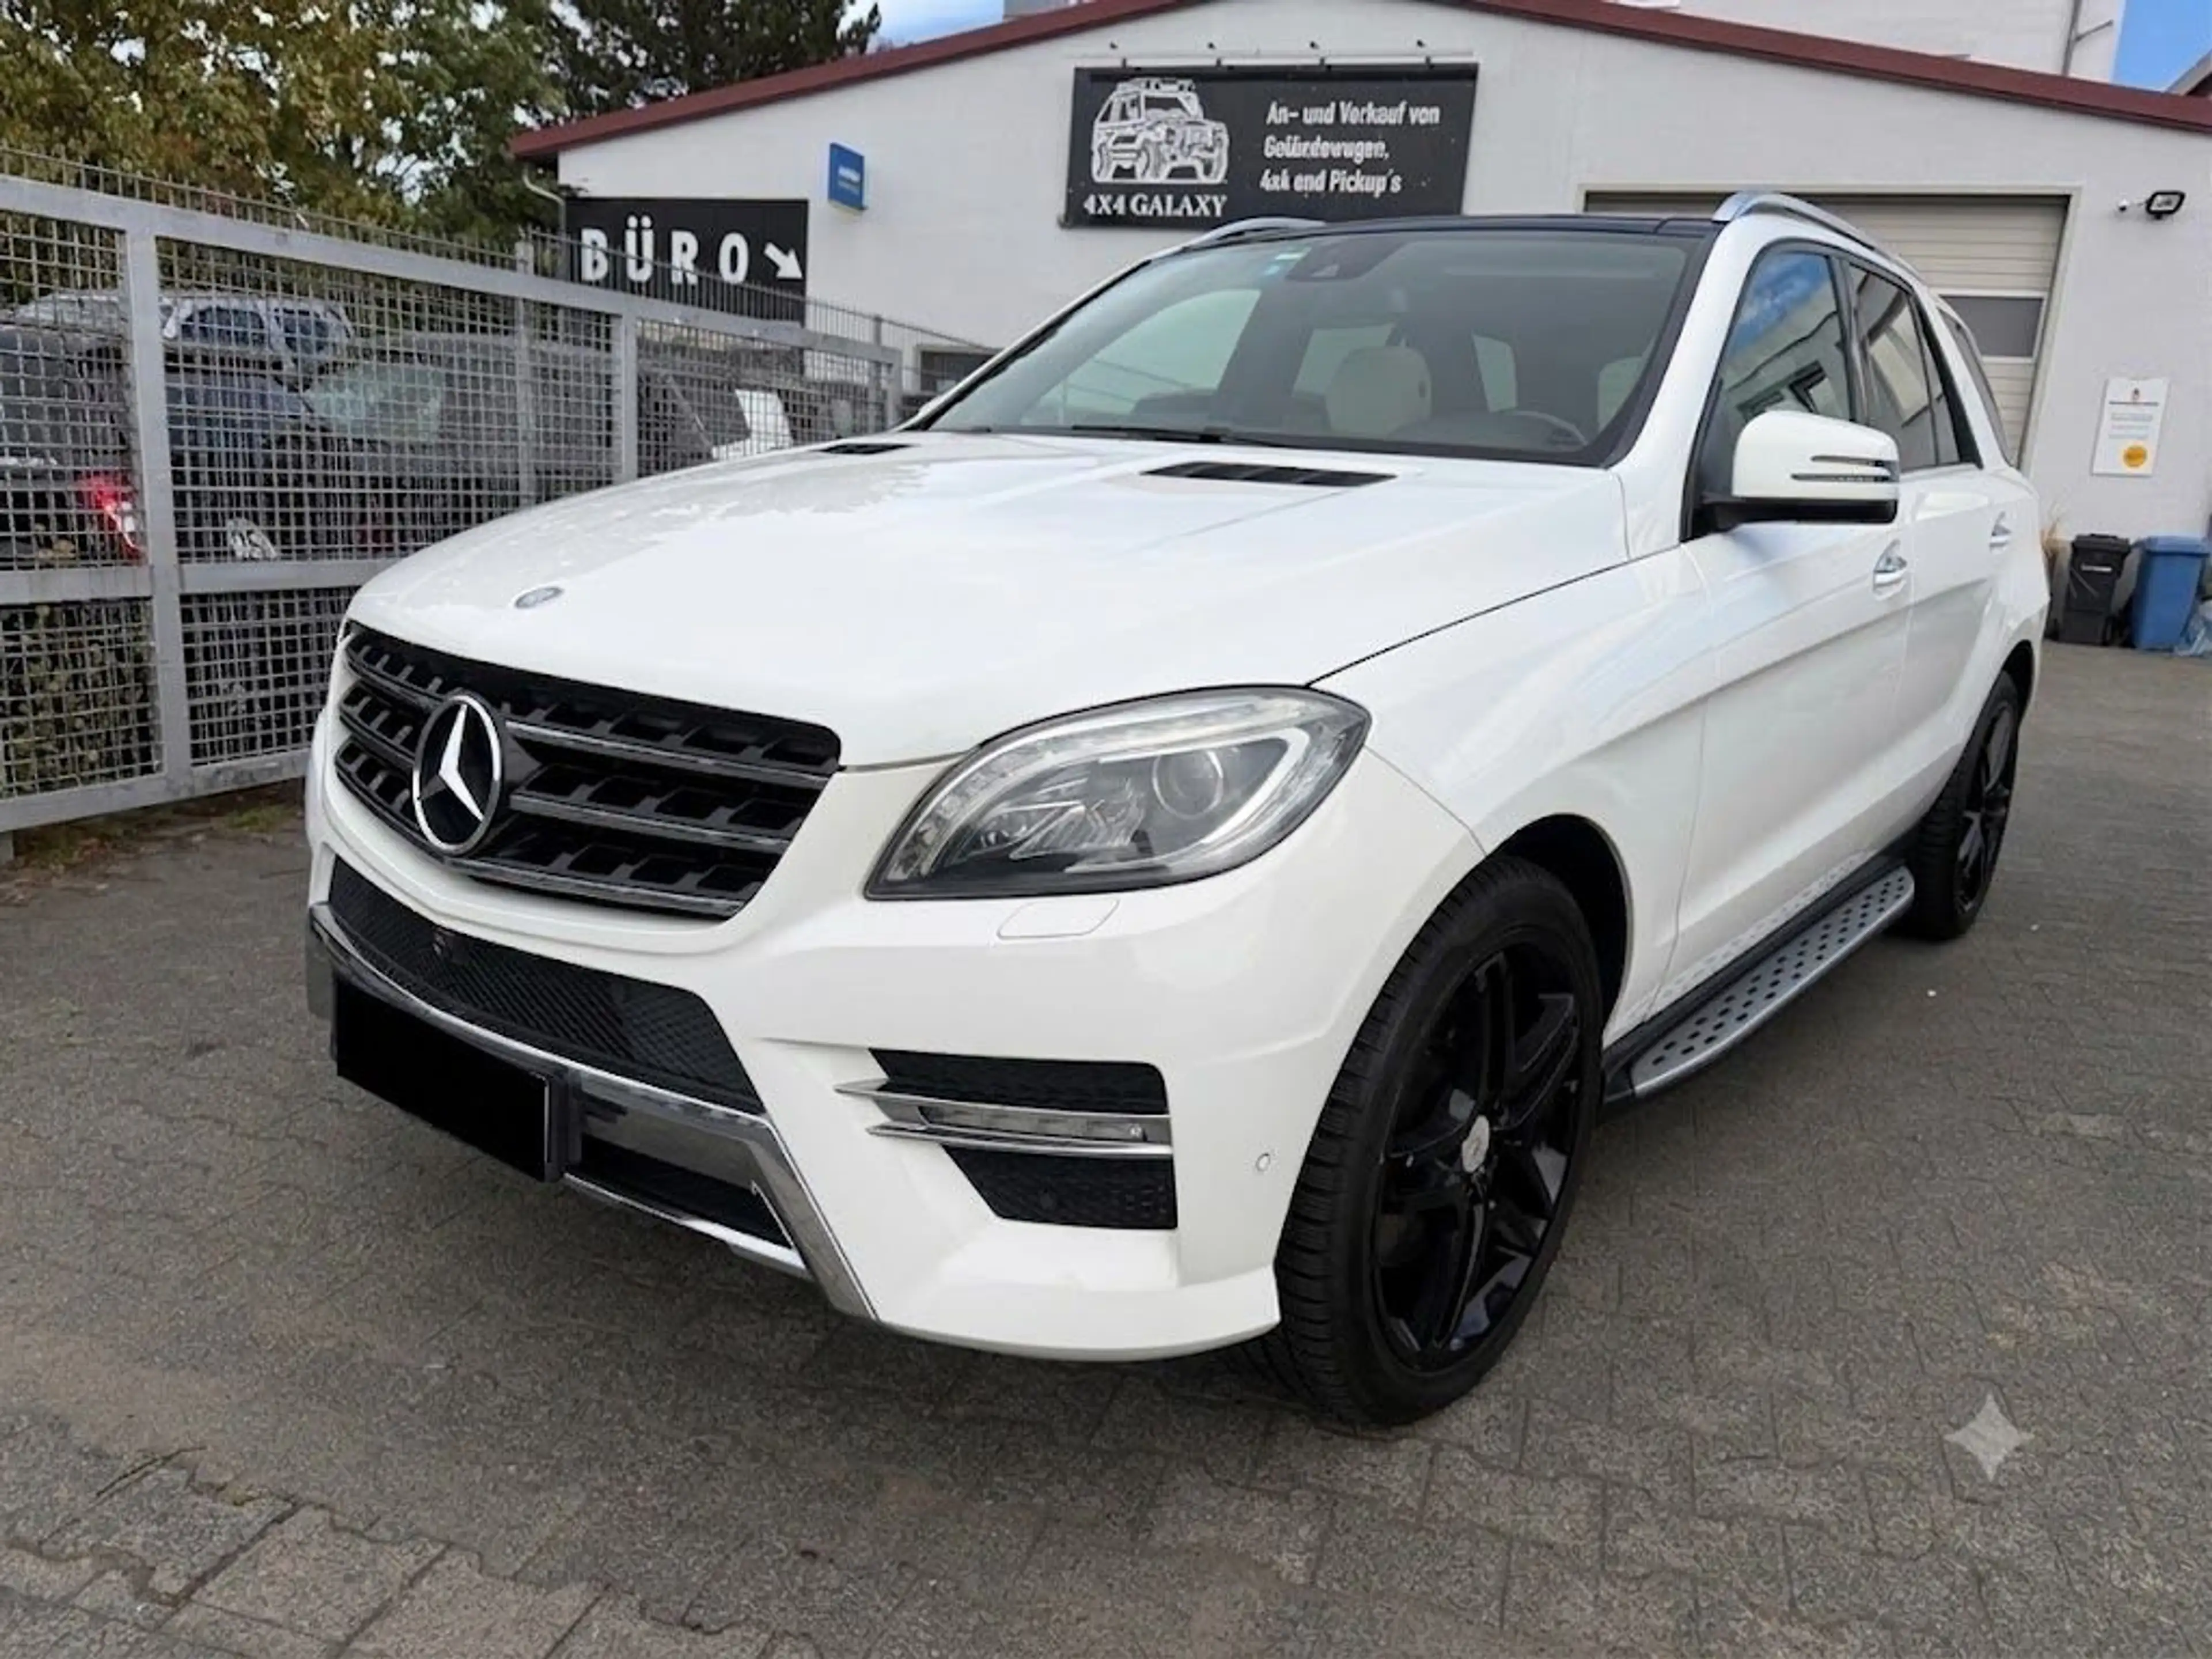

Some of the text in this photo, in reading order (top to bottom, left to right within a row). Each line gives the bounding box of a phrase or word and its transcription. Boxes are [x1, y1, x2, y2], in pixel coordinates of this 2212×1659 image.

[1084, 192, 1228, 218] 4X4 GALAXY
[581, 215, 749, 285] BÜRO
